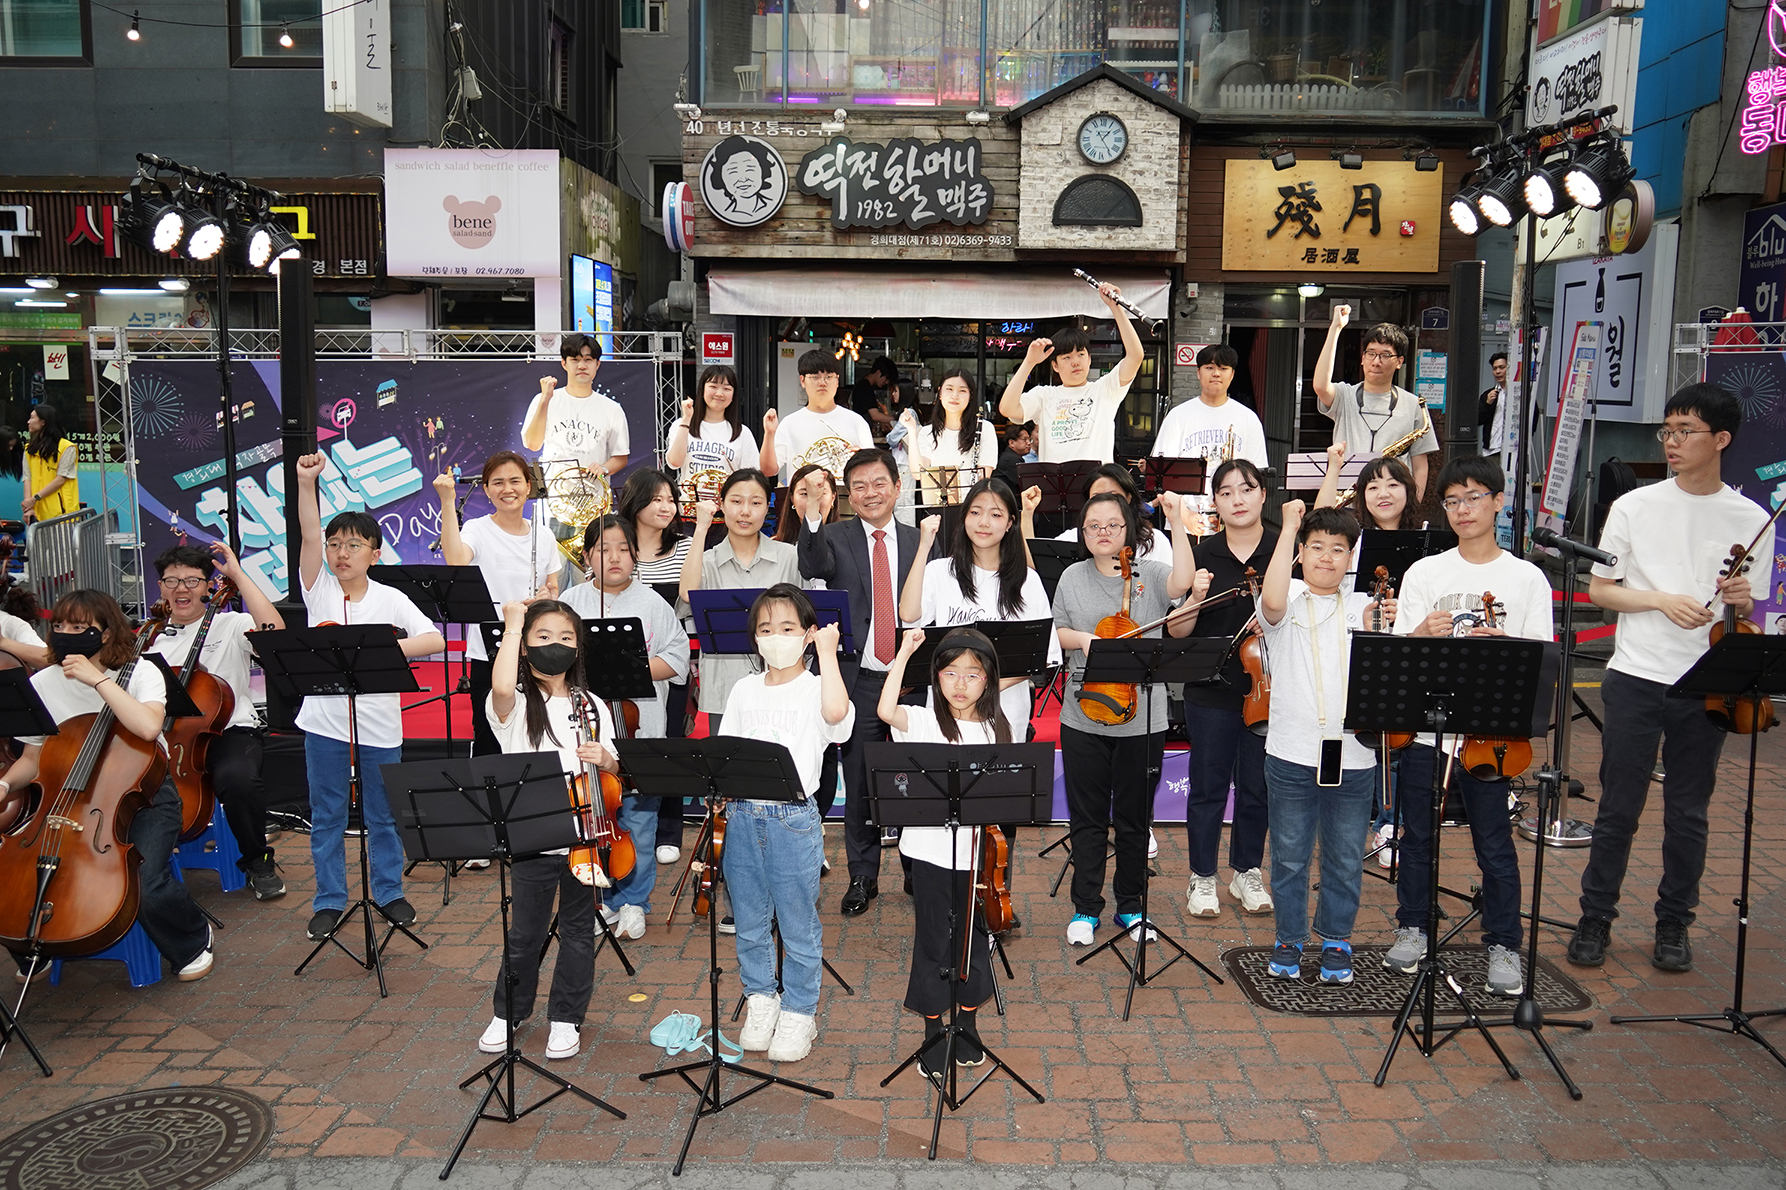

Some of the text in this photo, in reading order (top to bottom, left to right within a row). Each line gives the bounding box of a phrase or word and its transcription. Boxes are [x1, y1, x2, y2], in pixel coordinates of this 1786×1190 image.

[687, 121, 703, 134] 40
[395, 161, 550, 172] sandwich salad beneffle coffee
[683, 200, 695, 215] TAKE
[857, 200, 898, 219] 1982
[453, 214, 492, 229] bene
[685, 220, 694, 236] OUT
[944, 234, 1012, 246] 02)6369-9433
[1301, 247, 1361, 265] 居酒屋
[340, 259, 368, 274] 본점
[475, 267, 525, 275] 02.967.7080
[1432, 318, 1439, 327] 7
[708, 341, 729, 350] 에스원
[1185, 429, 1224, 452] RETRIEVER
[379, 503, 443, 547] Day
